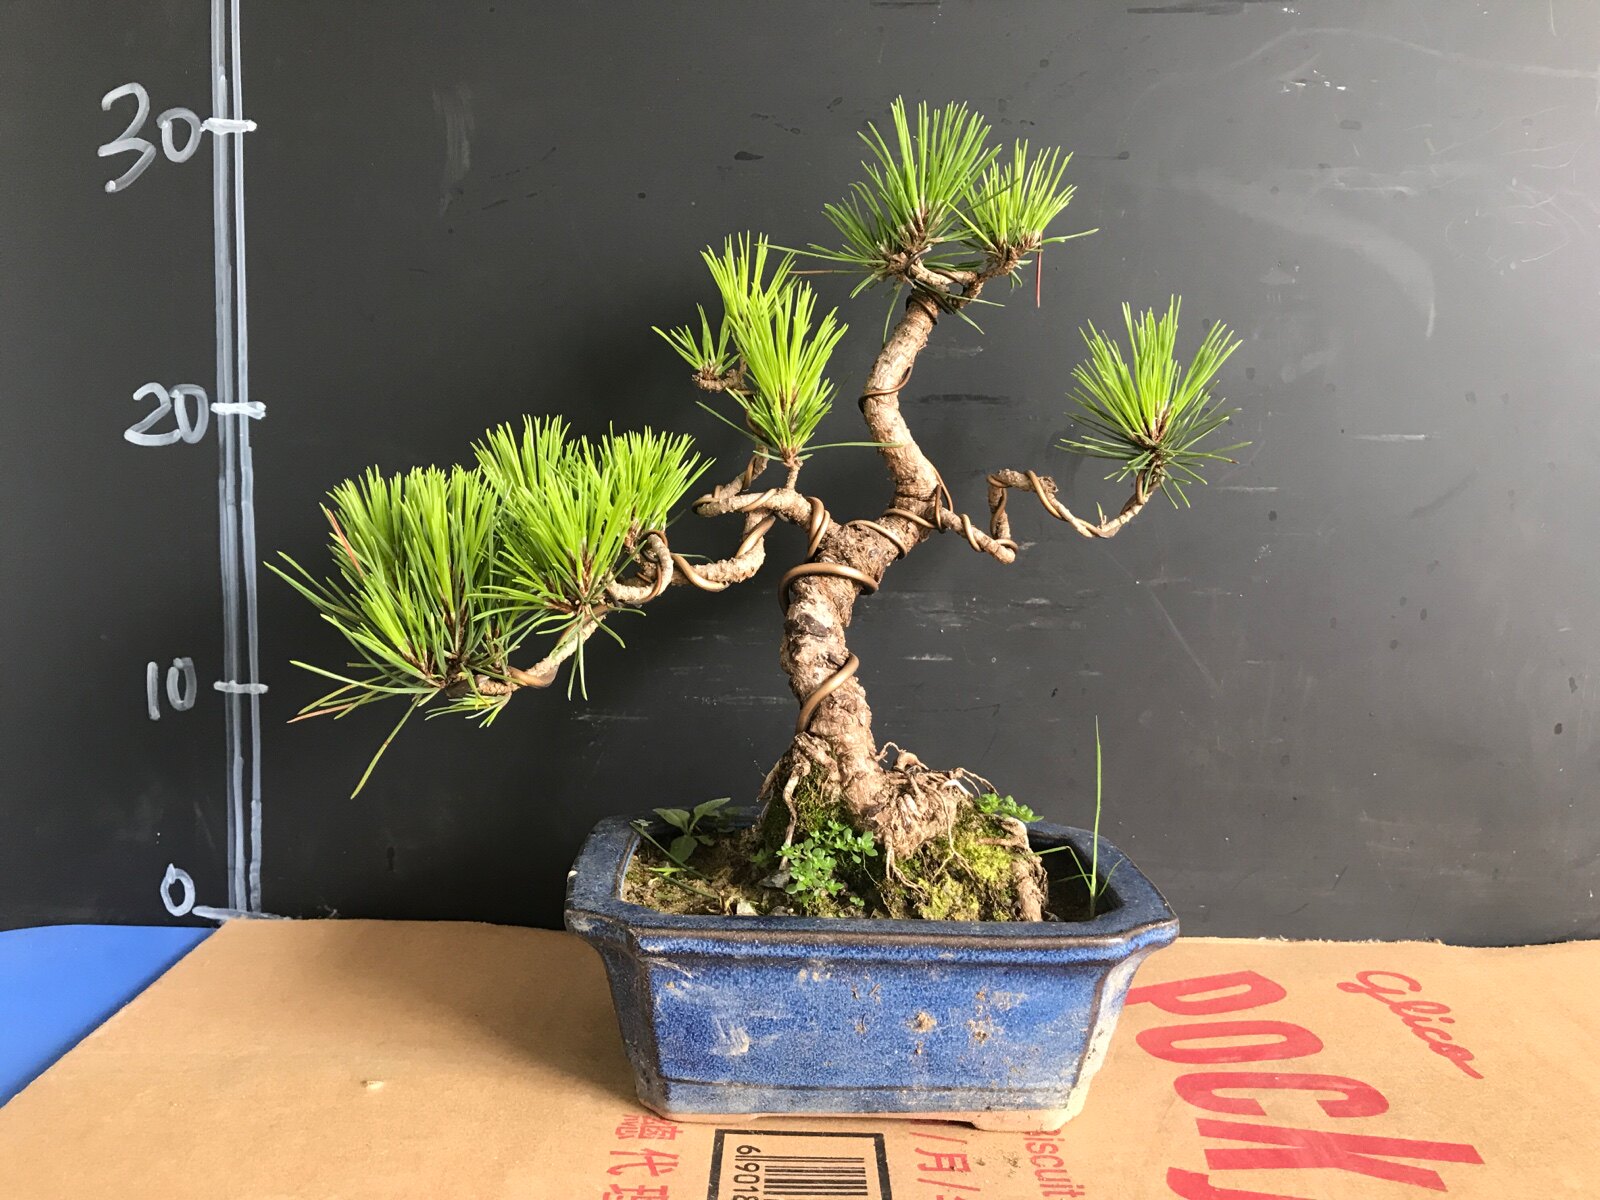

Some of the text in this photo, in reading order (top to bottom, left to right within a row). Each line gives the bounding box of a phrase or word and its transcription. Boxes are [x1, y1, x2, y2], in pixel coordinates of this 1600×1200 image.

[97, 82, 201, 192] 30
[124, 382, 208, 446] 20
[147, 657, 197, 721] 10
[160, 863, 196, 917] 0
[1336, 970, 1484, 1080] Glico
[1124, 970, 1485, 1200] POCK
